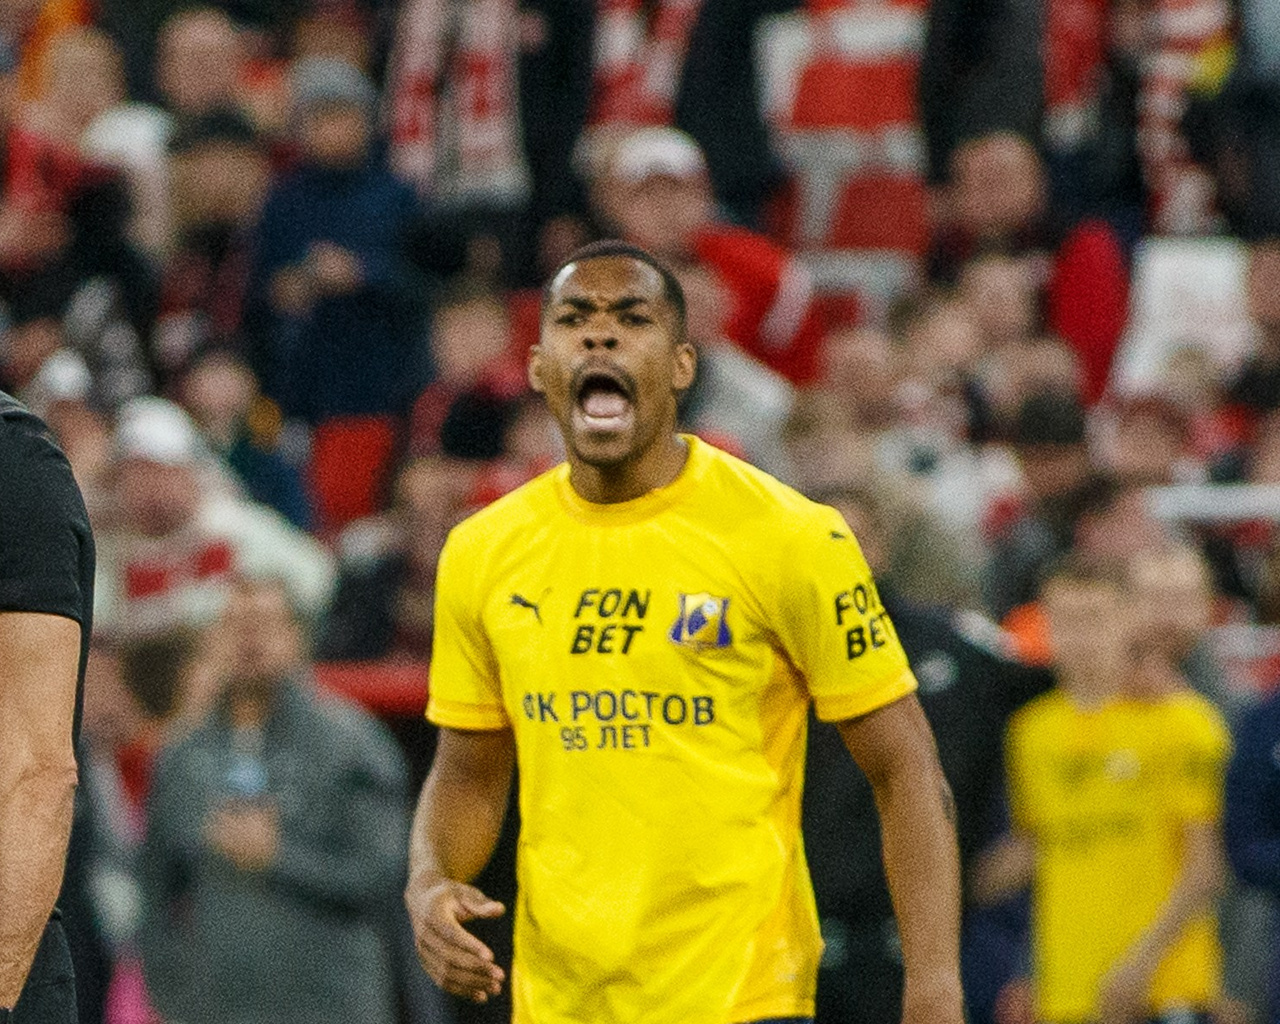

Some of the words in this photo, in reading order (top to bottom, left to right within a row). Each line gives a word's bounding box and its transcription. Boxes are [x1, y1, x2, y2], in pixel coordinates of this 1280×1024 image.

[574, 588, 651, 619] FON
[570, 624, 644, 655] BET
[571, 689, 715, 726] РОСТОВ
[560, 726, 589, 751] 95
[596, 724, 651, 749] ЛЕТ
